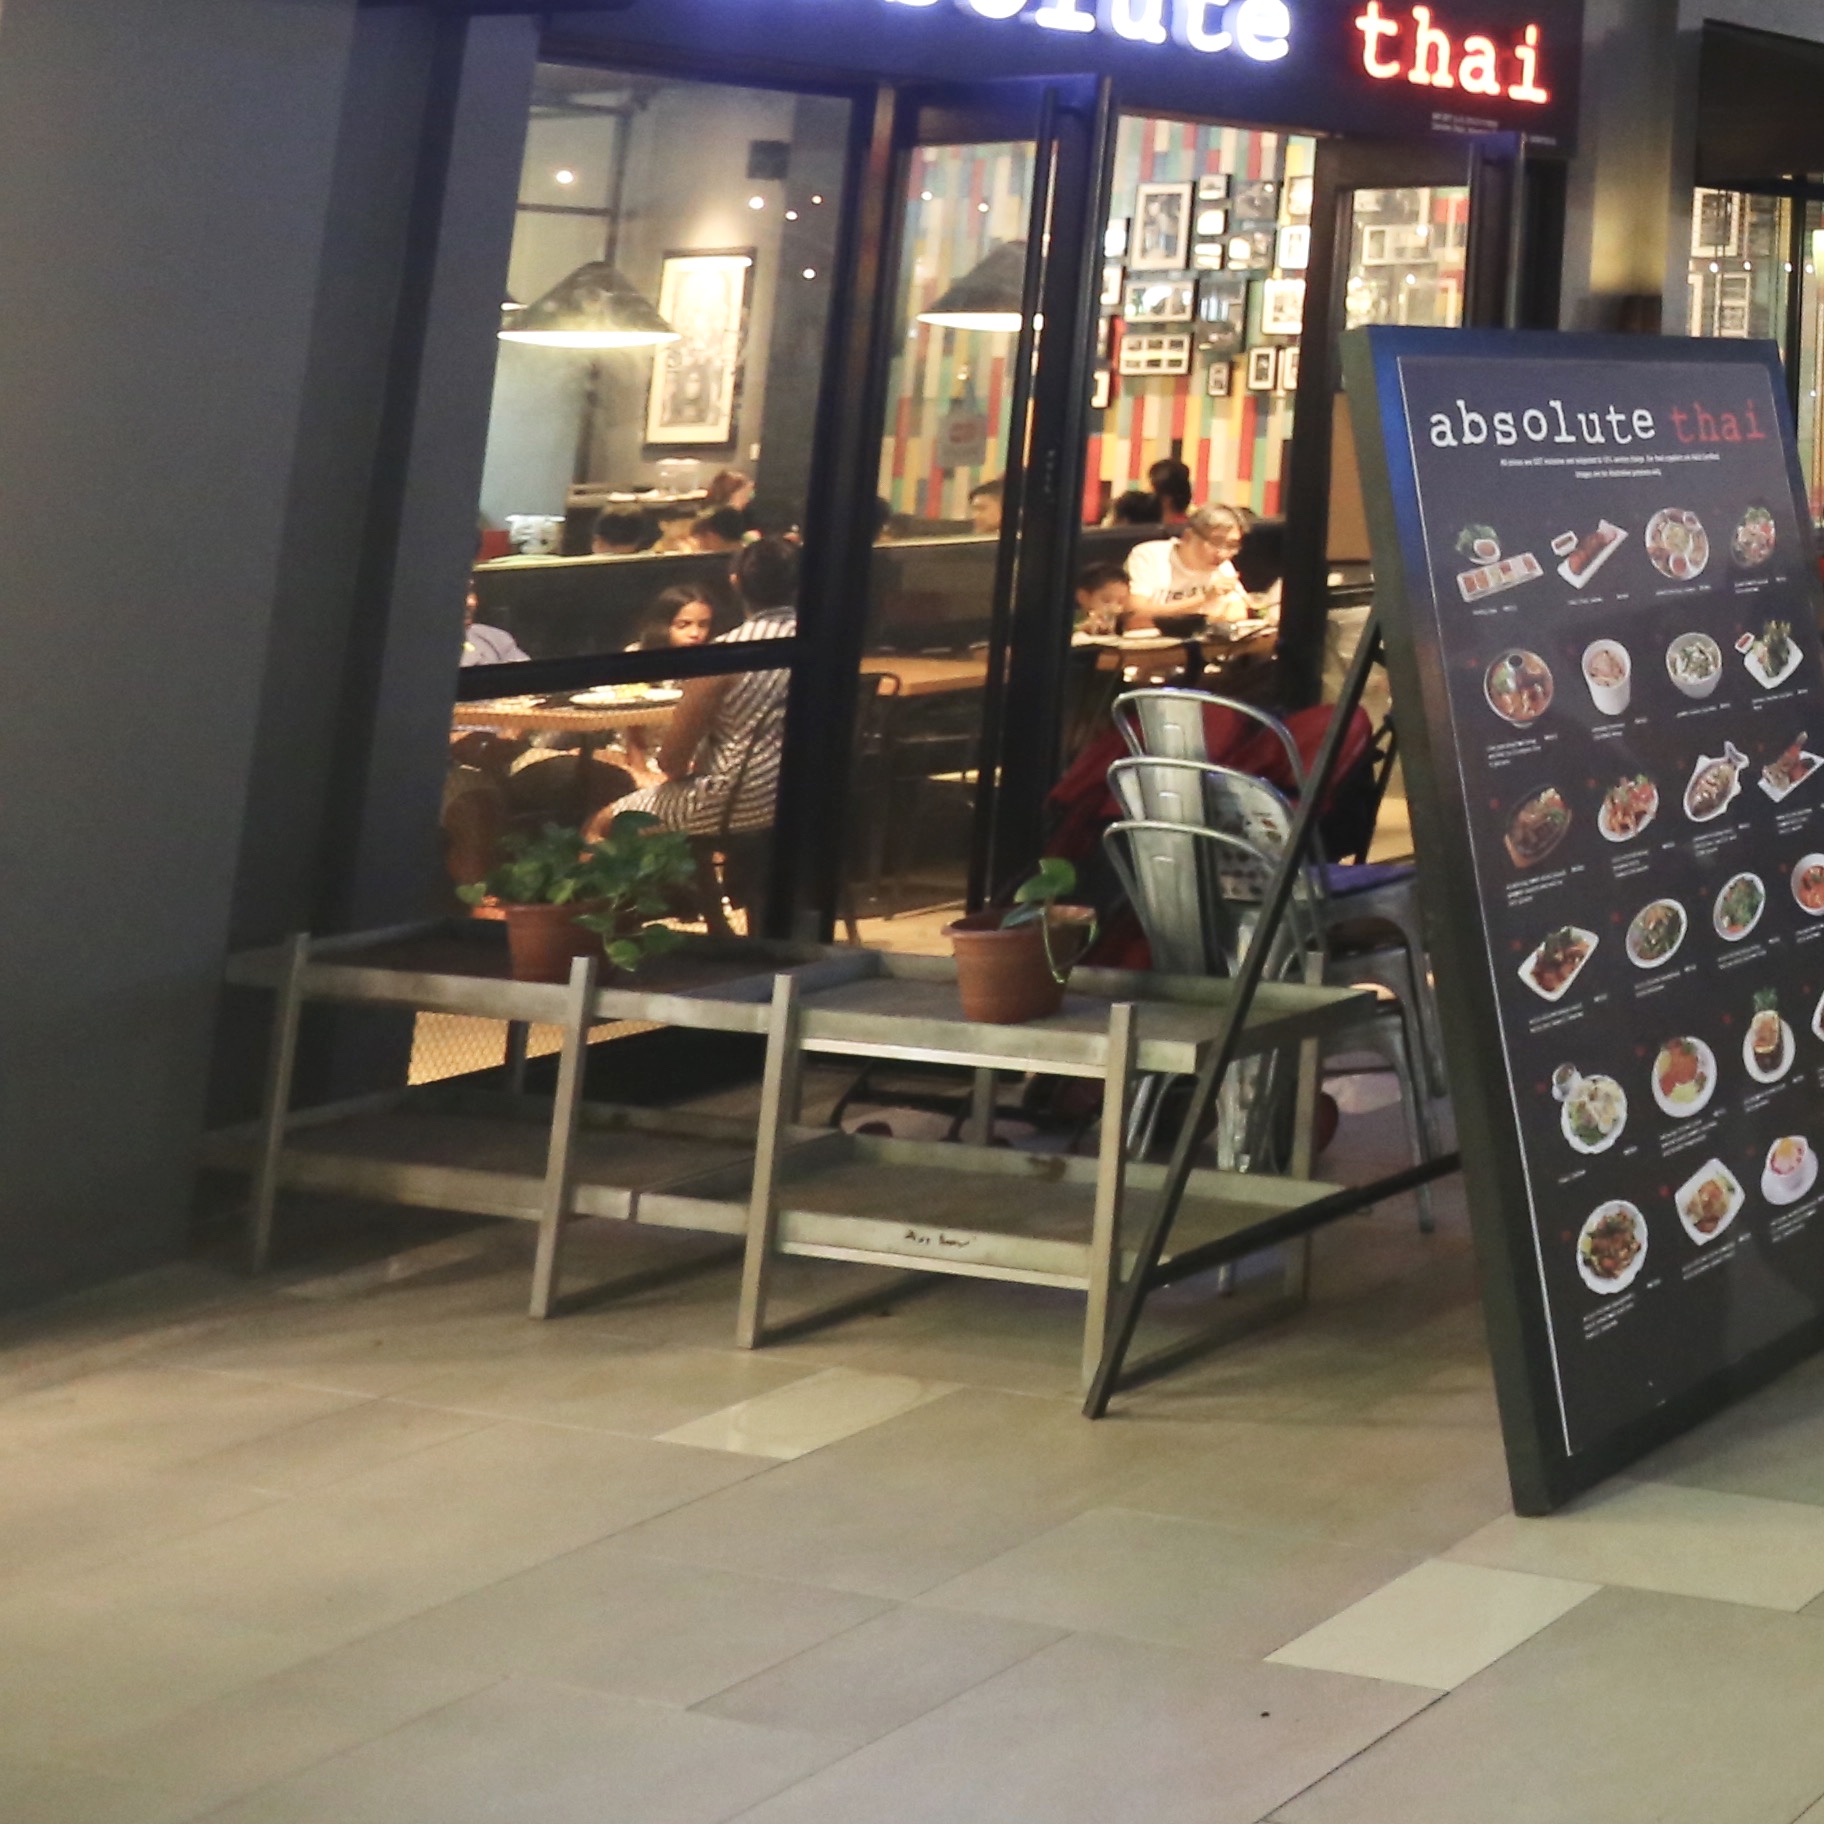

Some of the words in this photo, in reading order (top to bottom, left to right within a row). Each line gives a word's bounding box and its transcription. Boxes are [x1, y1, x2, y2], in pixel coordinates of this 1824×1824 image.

[1354, 0, 1549, 104] thai
[1429, 398, 1656, 447] absolute
[1669, 400, 1766, 445] thai
